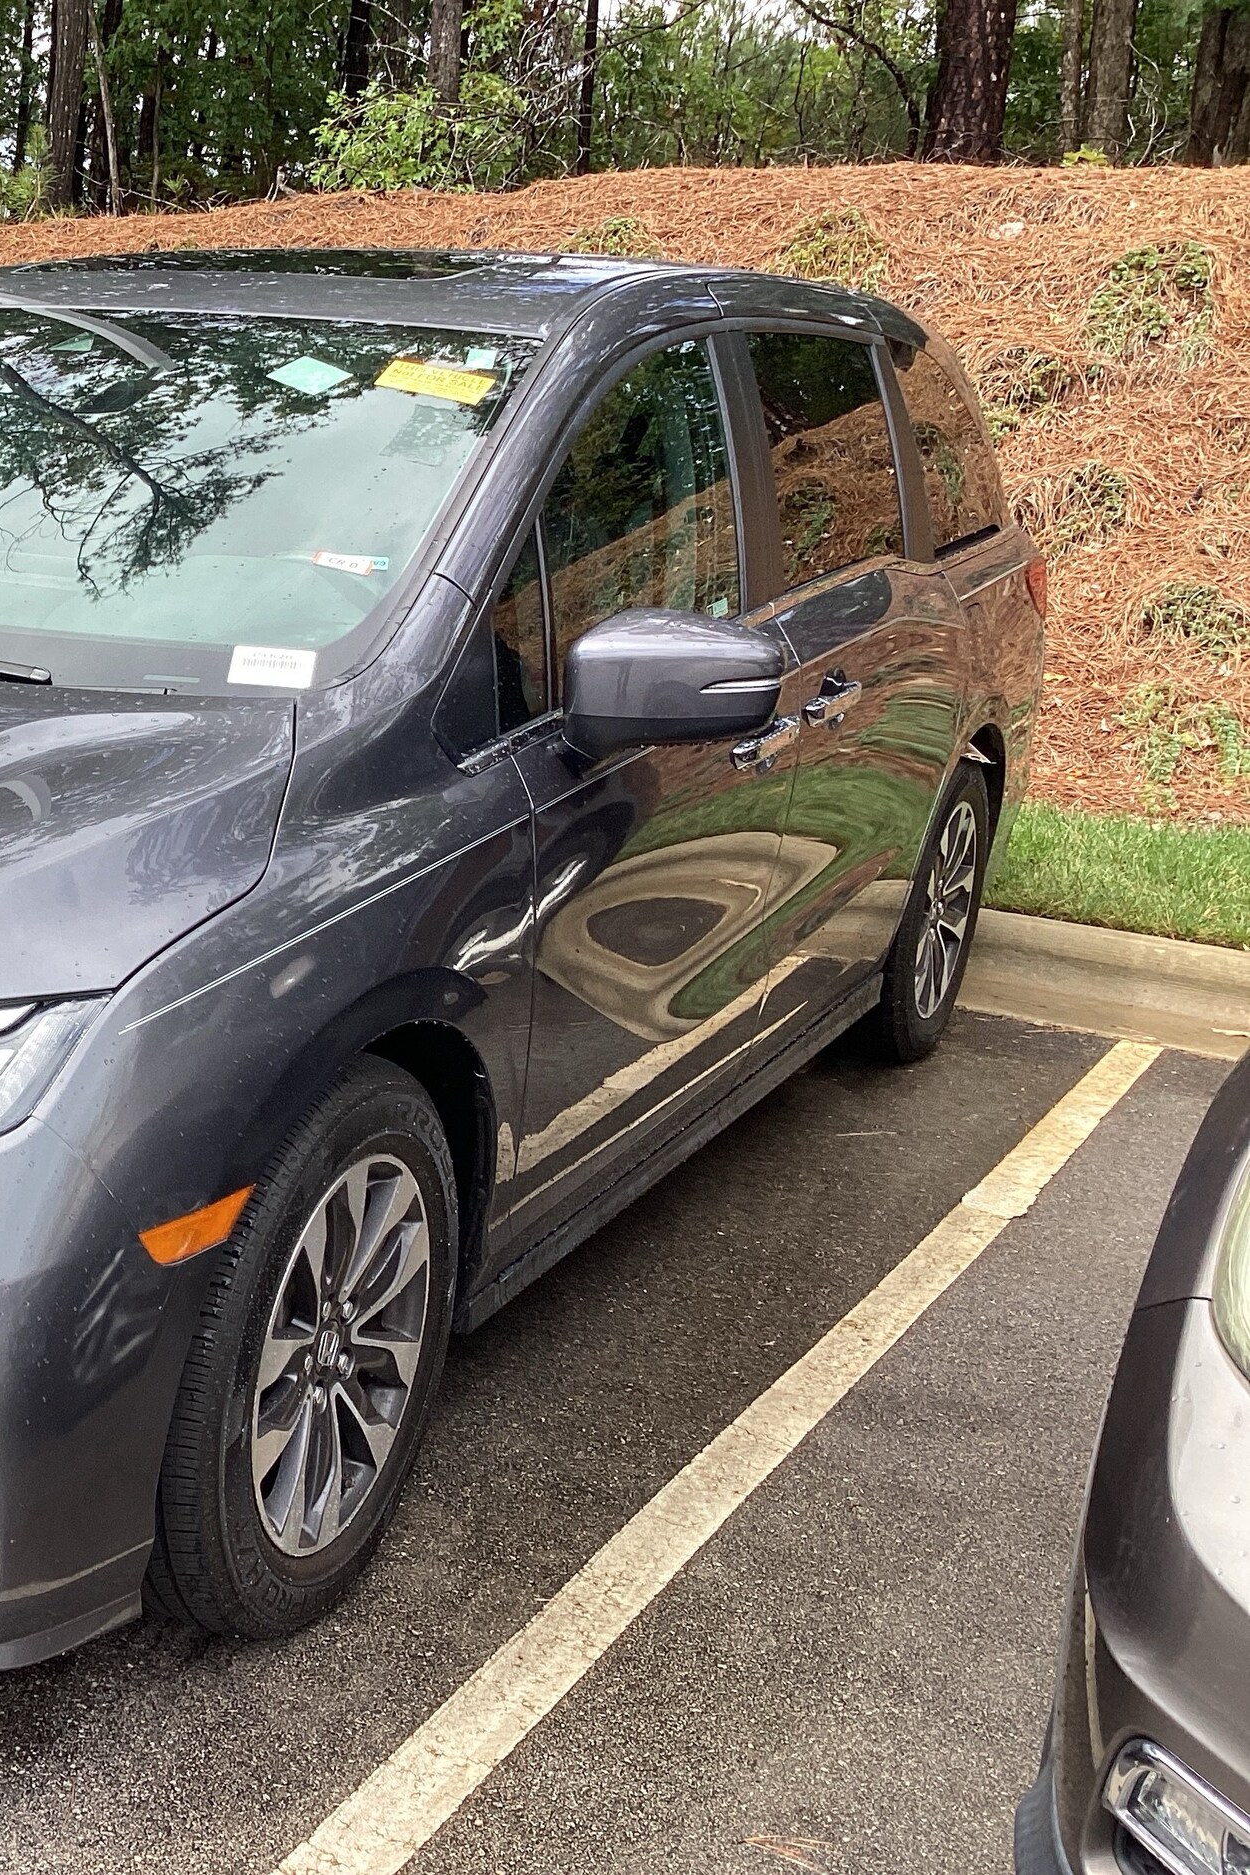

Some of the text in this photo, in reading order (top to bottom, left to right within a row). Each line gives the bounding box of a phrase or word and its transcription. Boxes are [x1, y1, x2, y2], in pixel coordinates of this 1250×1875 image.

[398, 362, 487, 384] THIS VEHICLE
[417, 371, 446, 384] FOR
[449, 378, 486, 391] SALE
